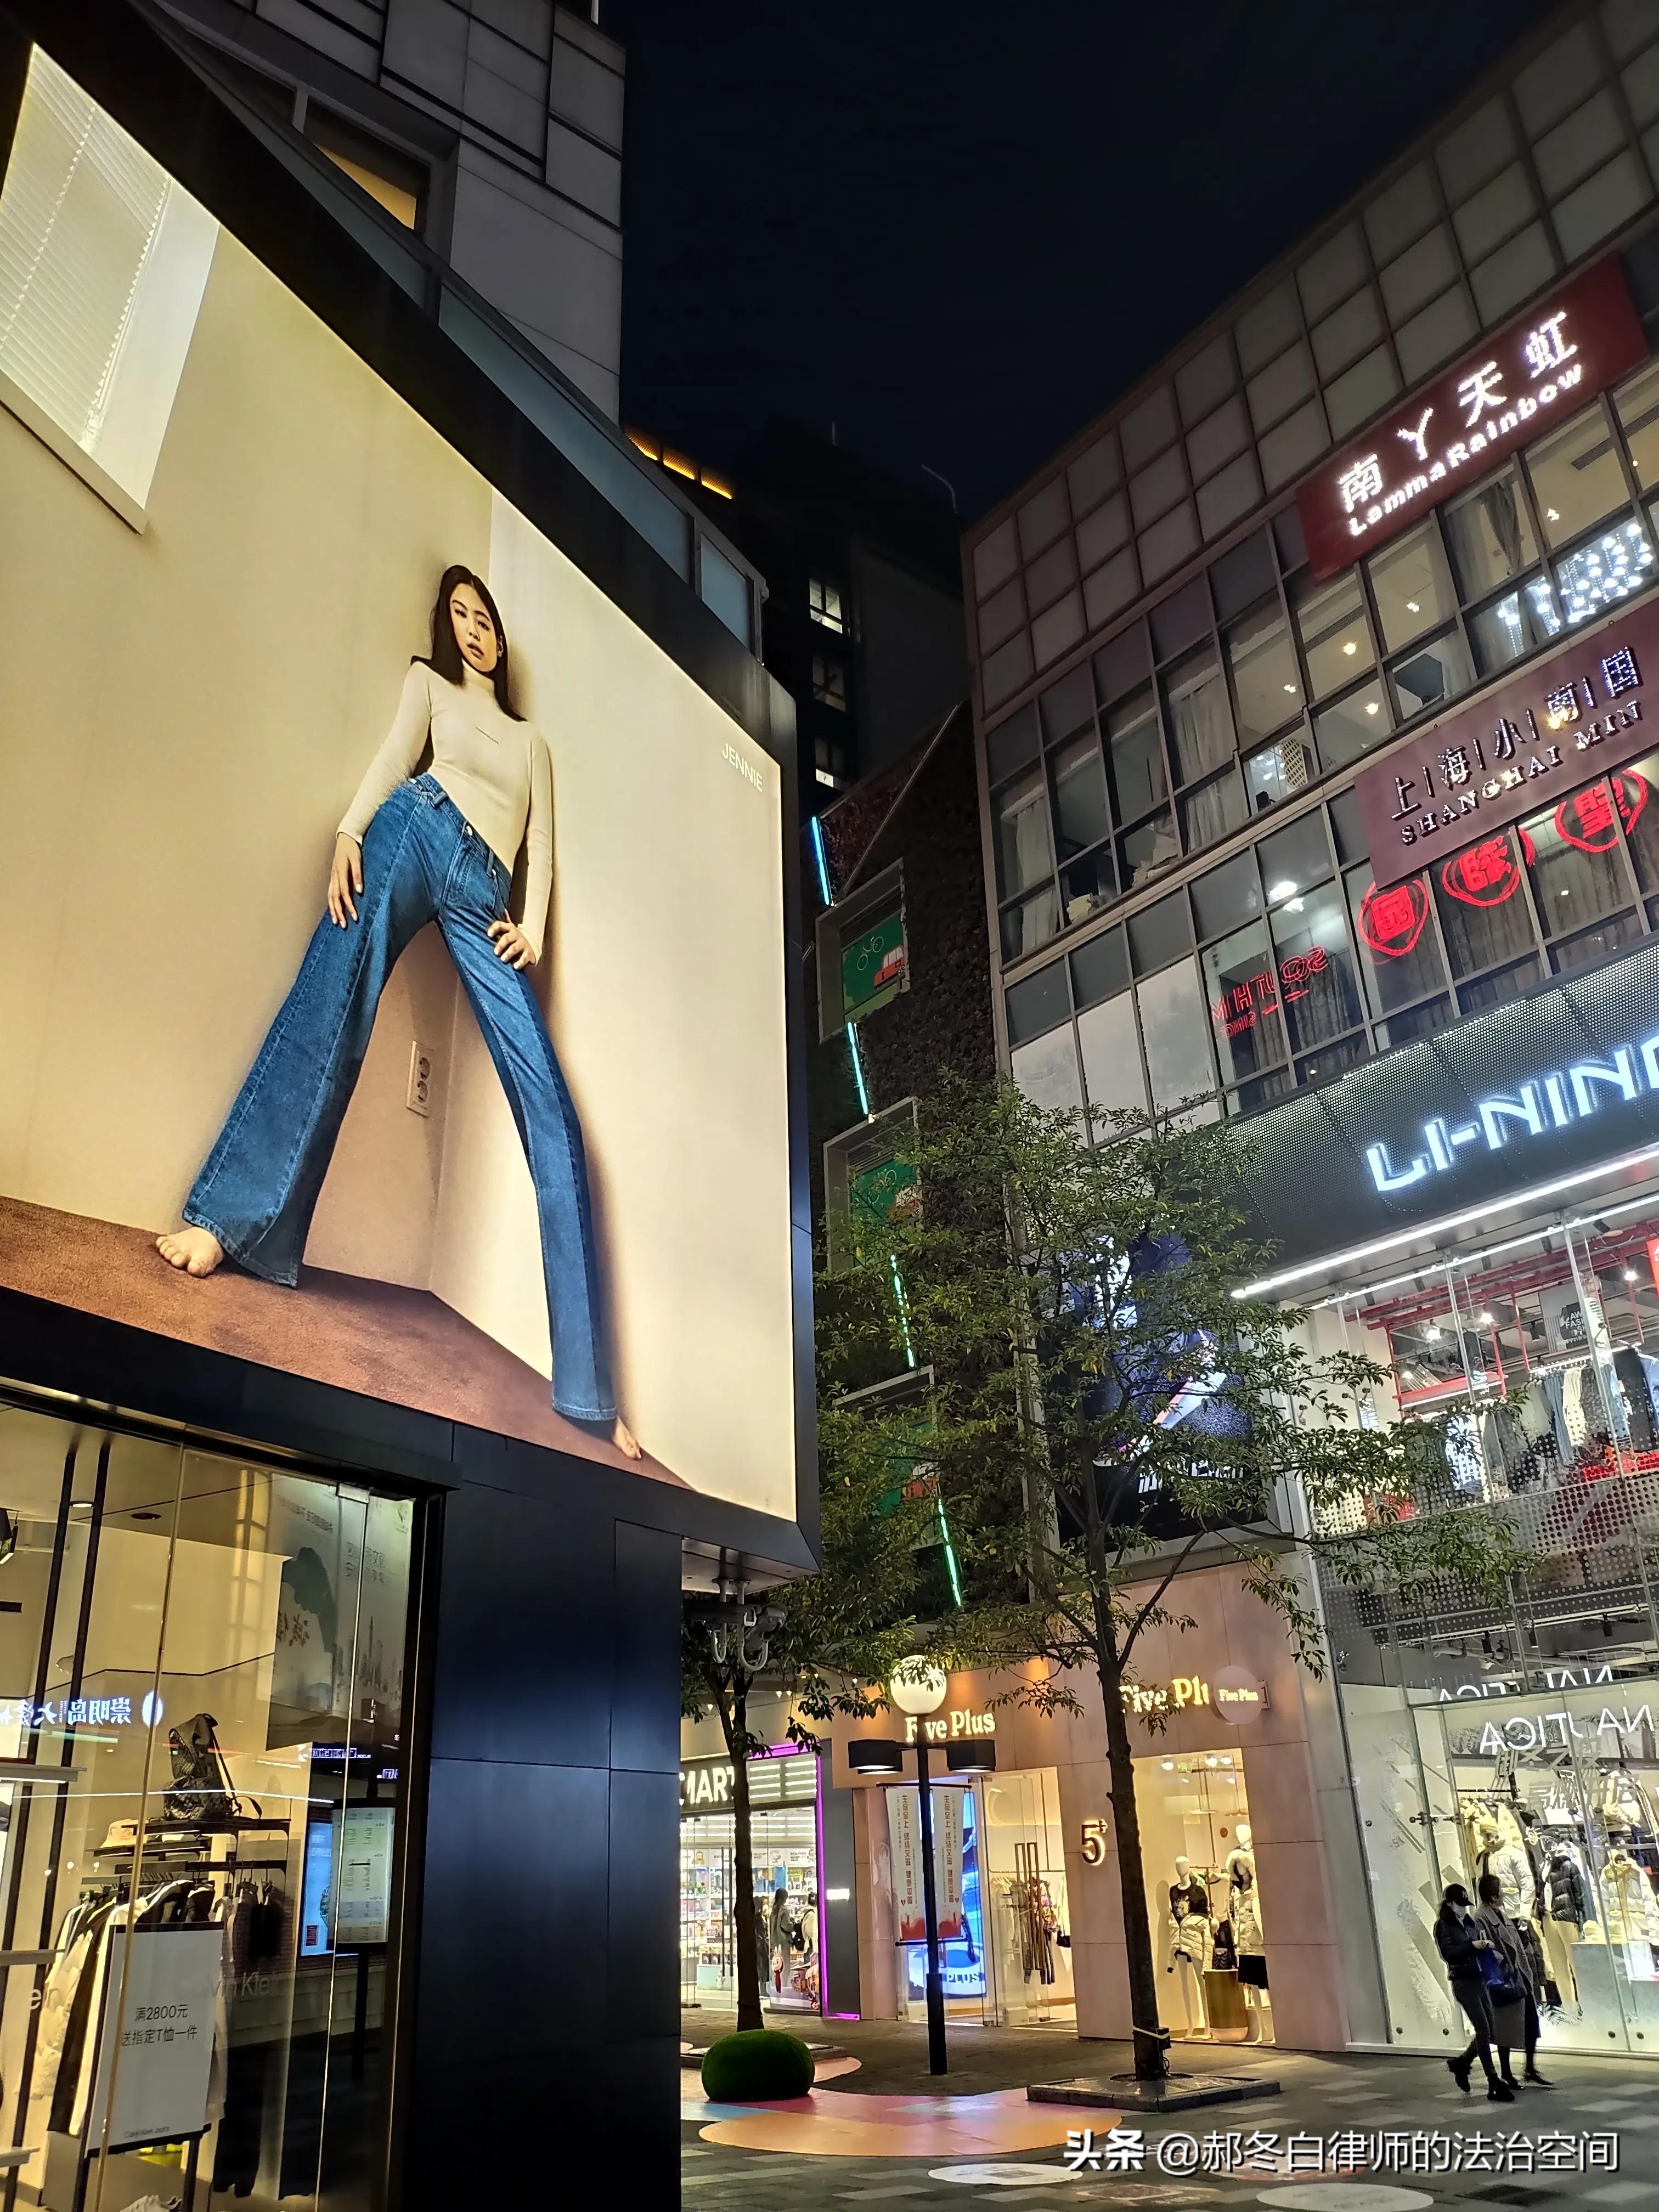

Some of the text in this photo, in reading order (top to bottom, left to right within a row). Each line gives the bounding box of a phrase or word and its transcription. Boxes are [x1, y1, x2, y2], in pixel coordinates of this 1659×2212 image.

[1338, 311, 1578, 514] 南丫天虹
[1347, 363, 1584, 537] LammaRainbow
[722, 743, 763, 792] JENNIE
[1401, 700, 1642, 846] SHANGHAI MIN
[1219, 1688, 1259, 1702] Five Plus
[905, 1708, 996, 1743] Fve Plus
[947, 1973, 980, 1984] PLUS
[134, 2004, 189, 2022] 满2800元
[121, 2025, 198, 2046] 送指定T恤一件
